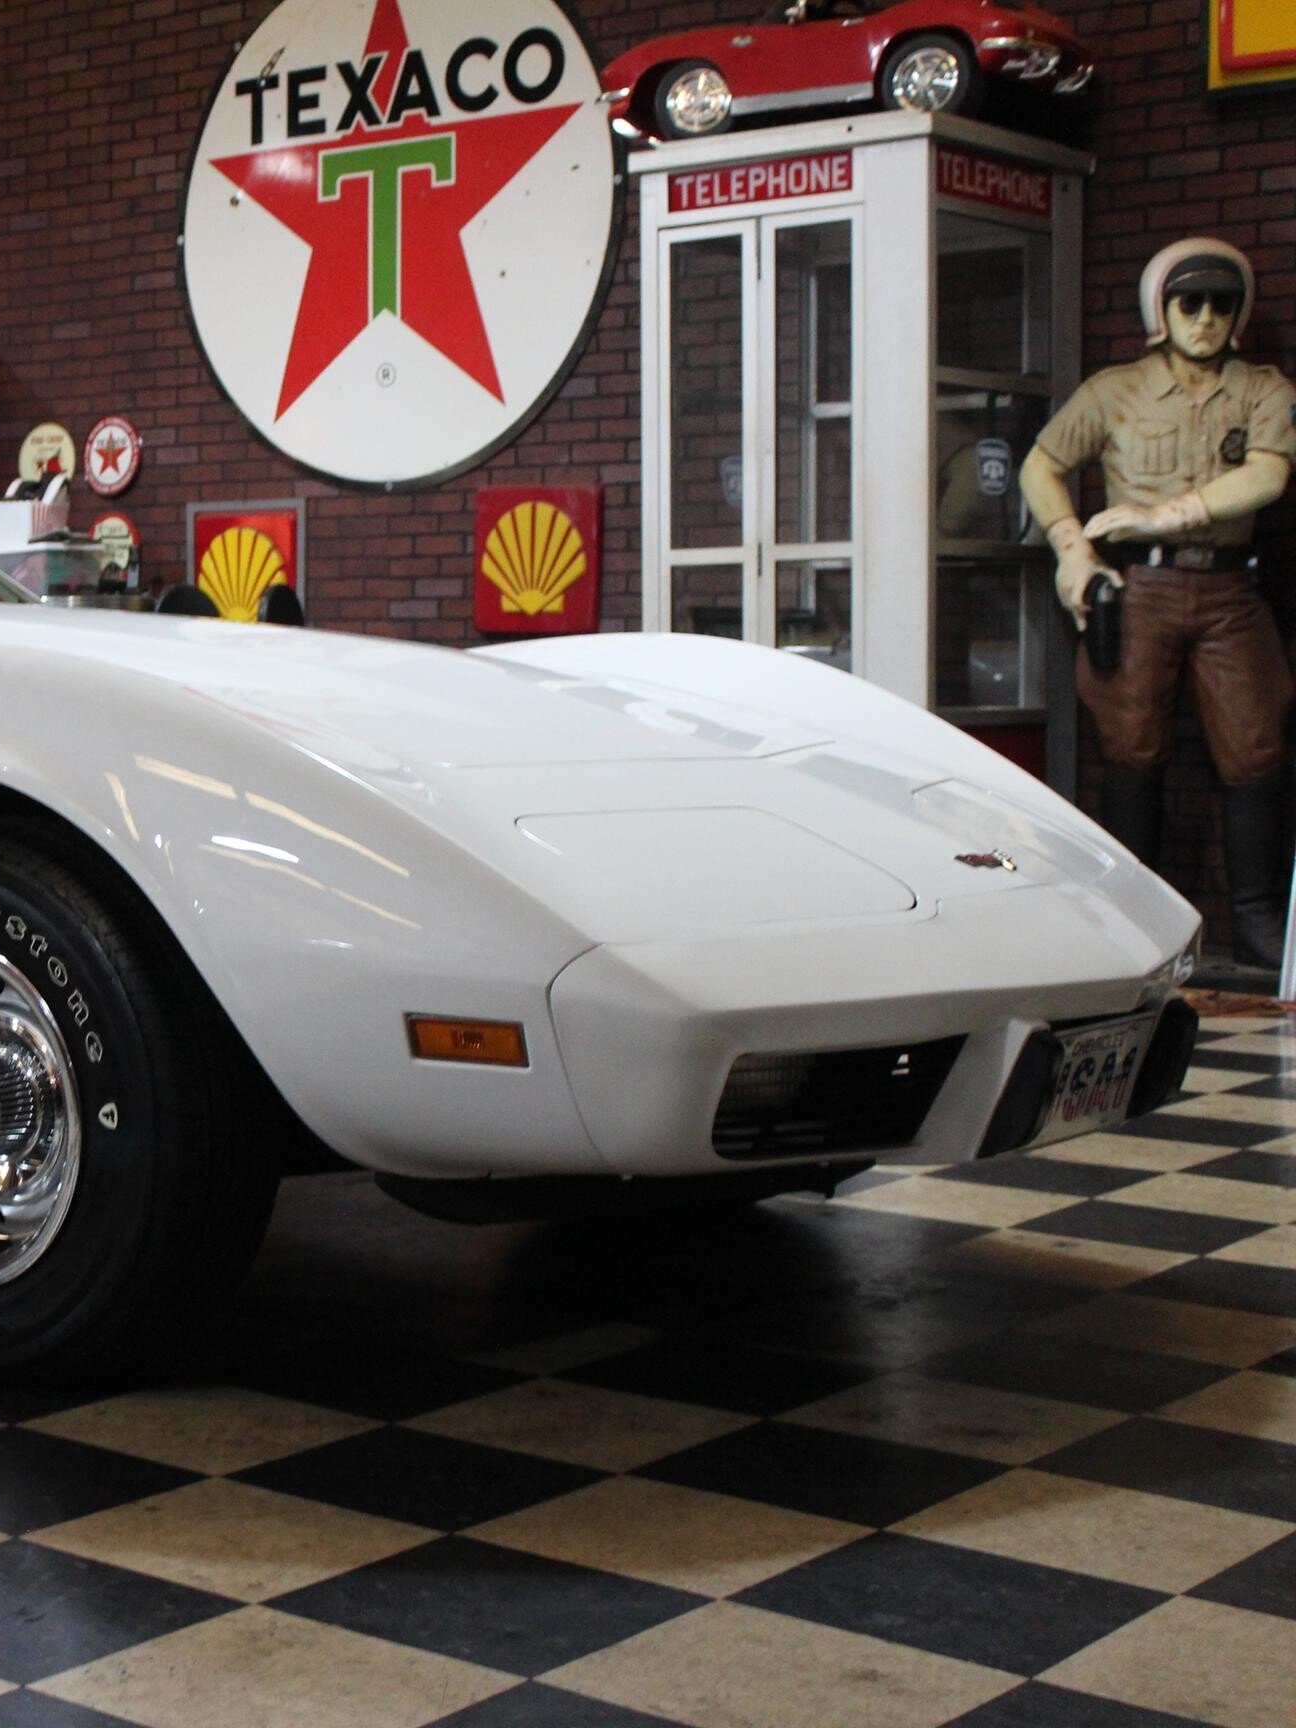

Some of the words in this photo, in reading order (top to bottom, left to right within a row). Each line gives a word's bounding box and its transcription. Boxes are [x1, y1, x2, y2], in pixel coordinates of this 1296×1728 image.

[235, 26, 565, 145] TEXACO
[675, 154, 850, 210] TELEPHONE
[940, 153, 1049, 211] TELEPHONE
